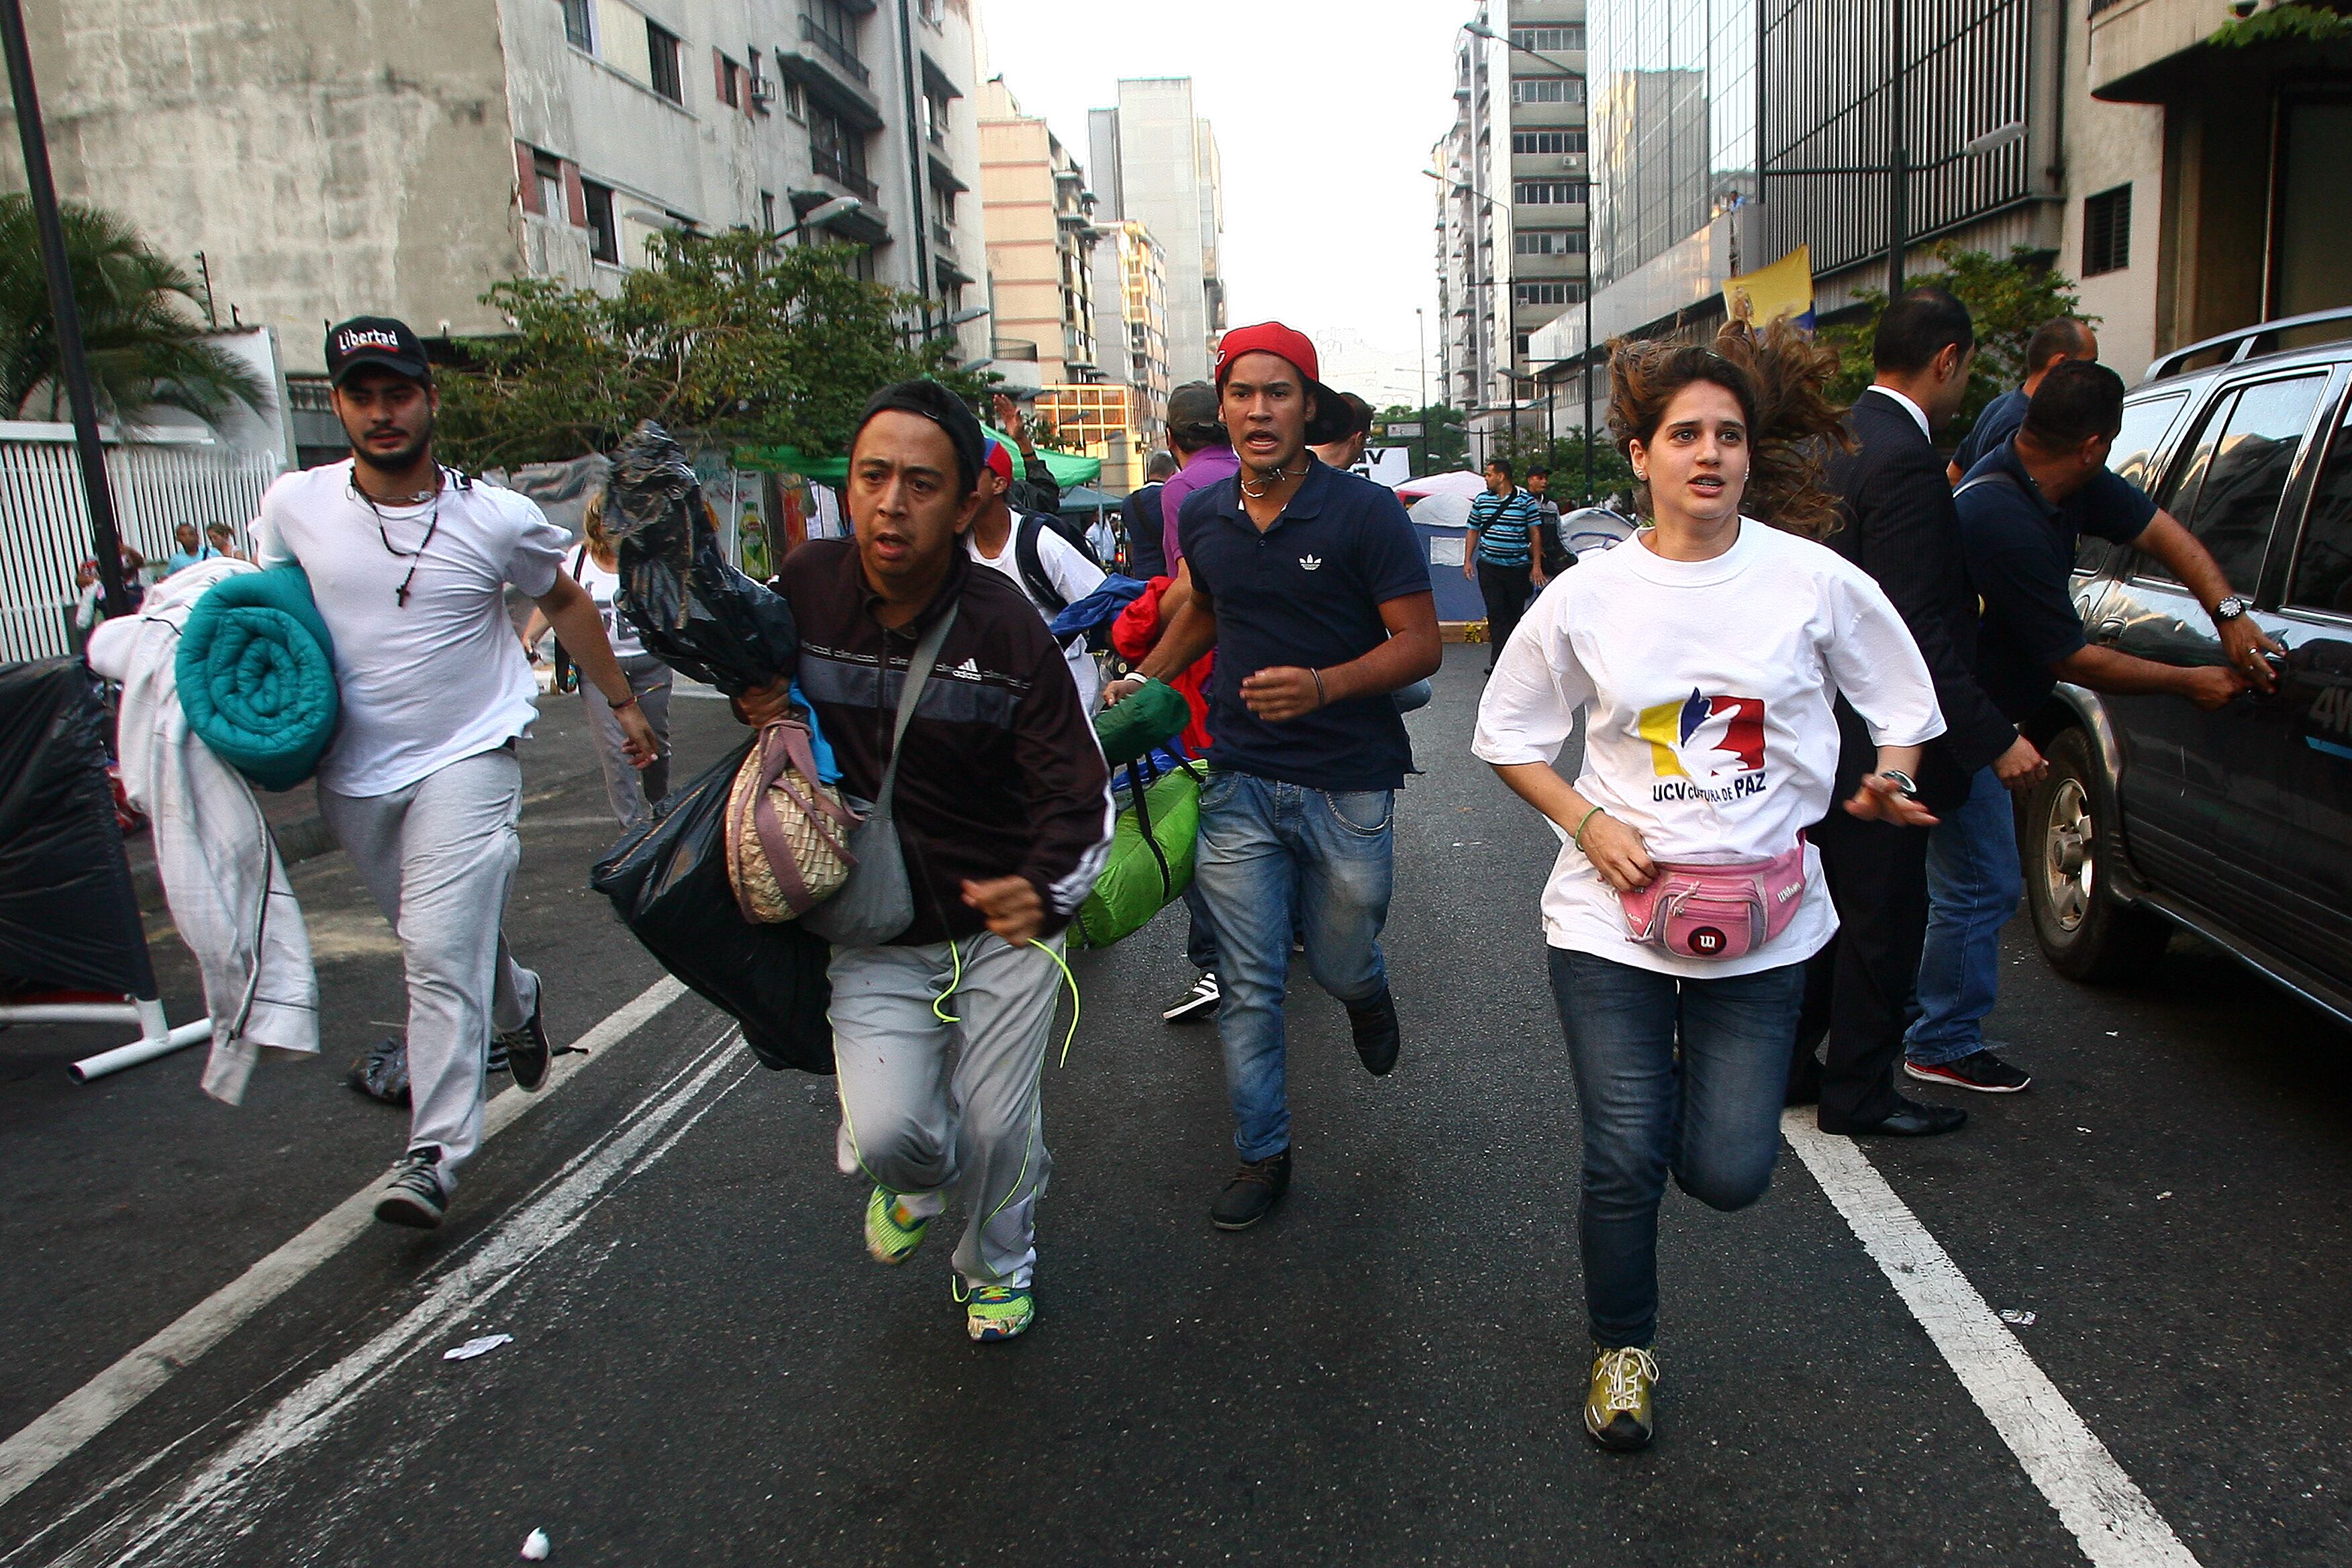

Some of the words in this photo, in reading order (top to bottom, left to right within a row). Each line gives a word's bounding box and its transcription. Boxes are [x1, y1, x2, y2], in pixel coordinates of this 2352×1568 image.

[338, 328, 397, 350] Libertad
[952, 670, 982, 681] adidas
[1653, 782, 1686, 802] UCV
[1721, 787, 1733, 801] DE
[1734, 772, 1767, 799] PAZ
